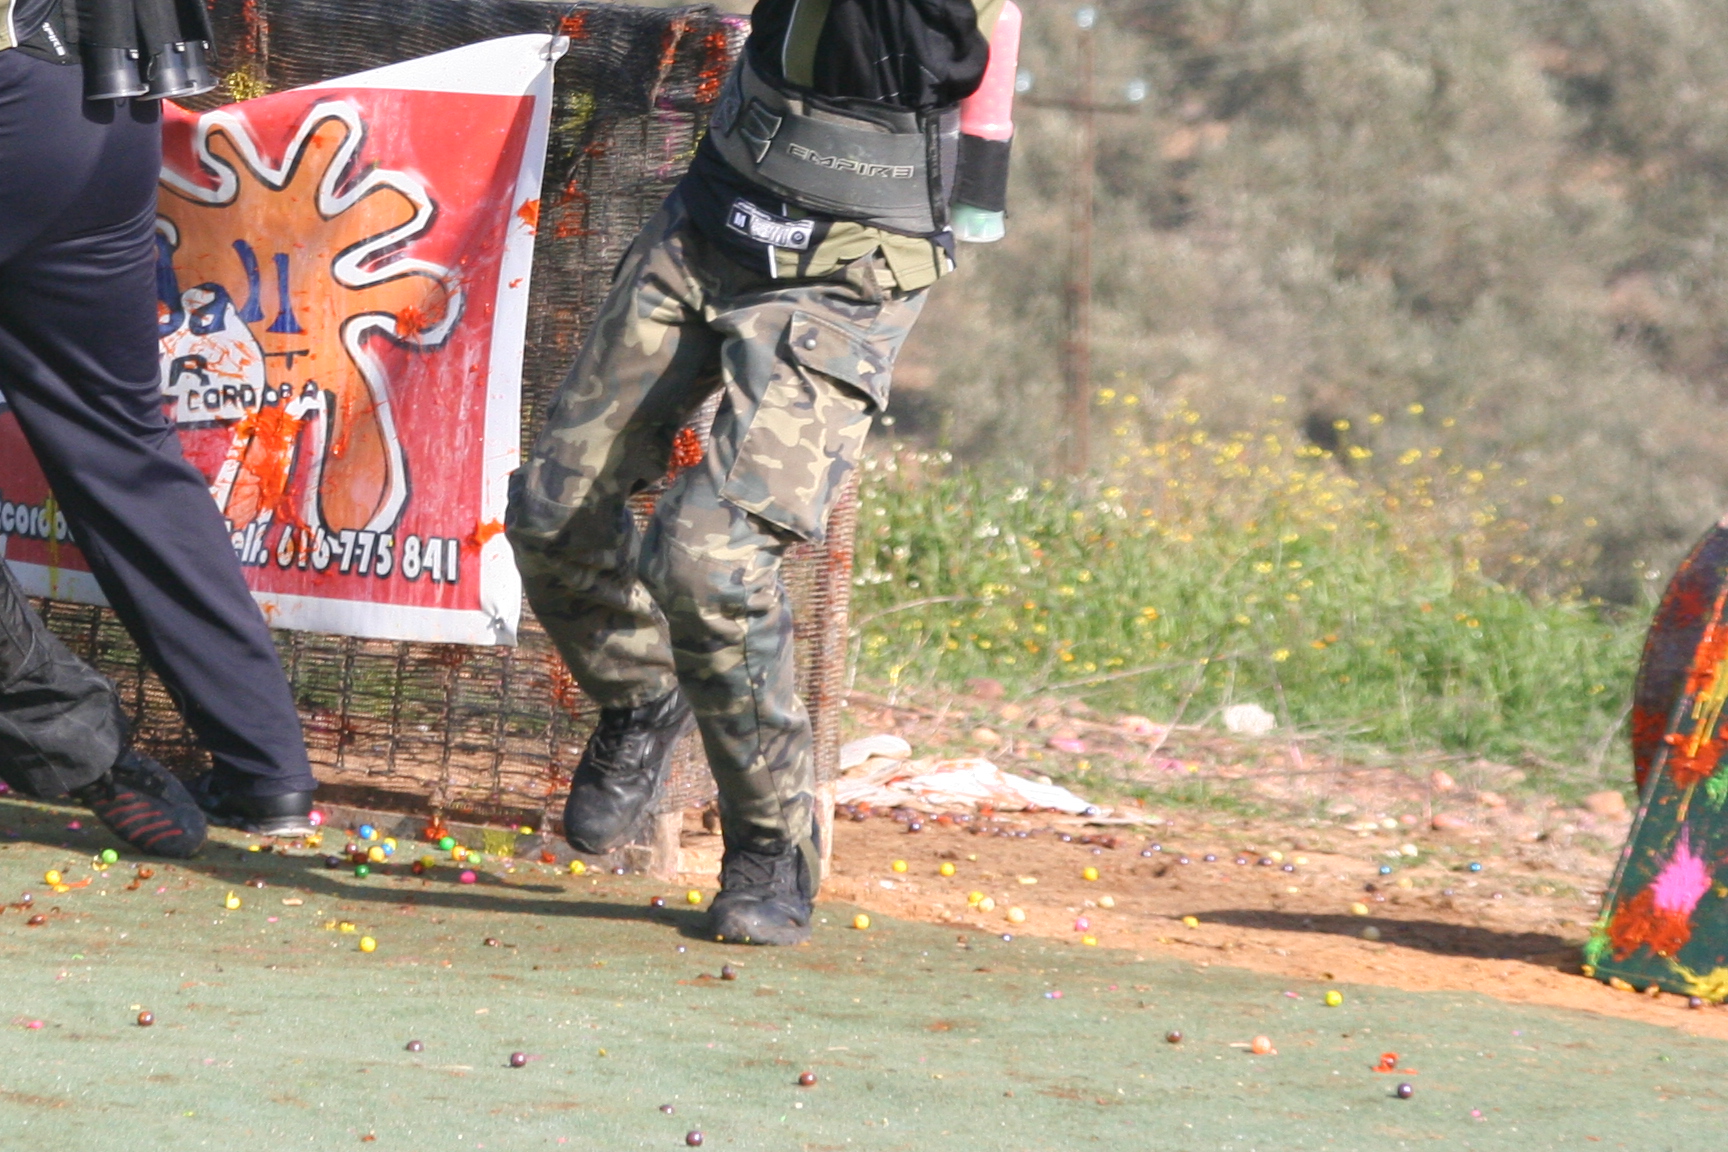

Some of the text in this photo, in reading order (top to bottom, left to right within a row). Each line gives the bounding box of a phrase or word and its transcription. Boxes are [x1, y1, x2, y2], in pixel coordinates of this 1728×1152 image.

[787, 142, 915, 179] EMPIRE
[224, 520, 269, 564] elf.
[402, 535, 459, 581] 841
